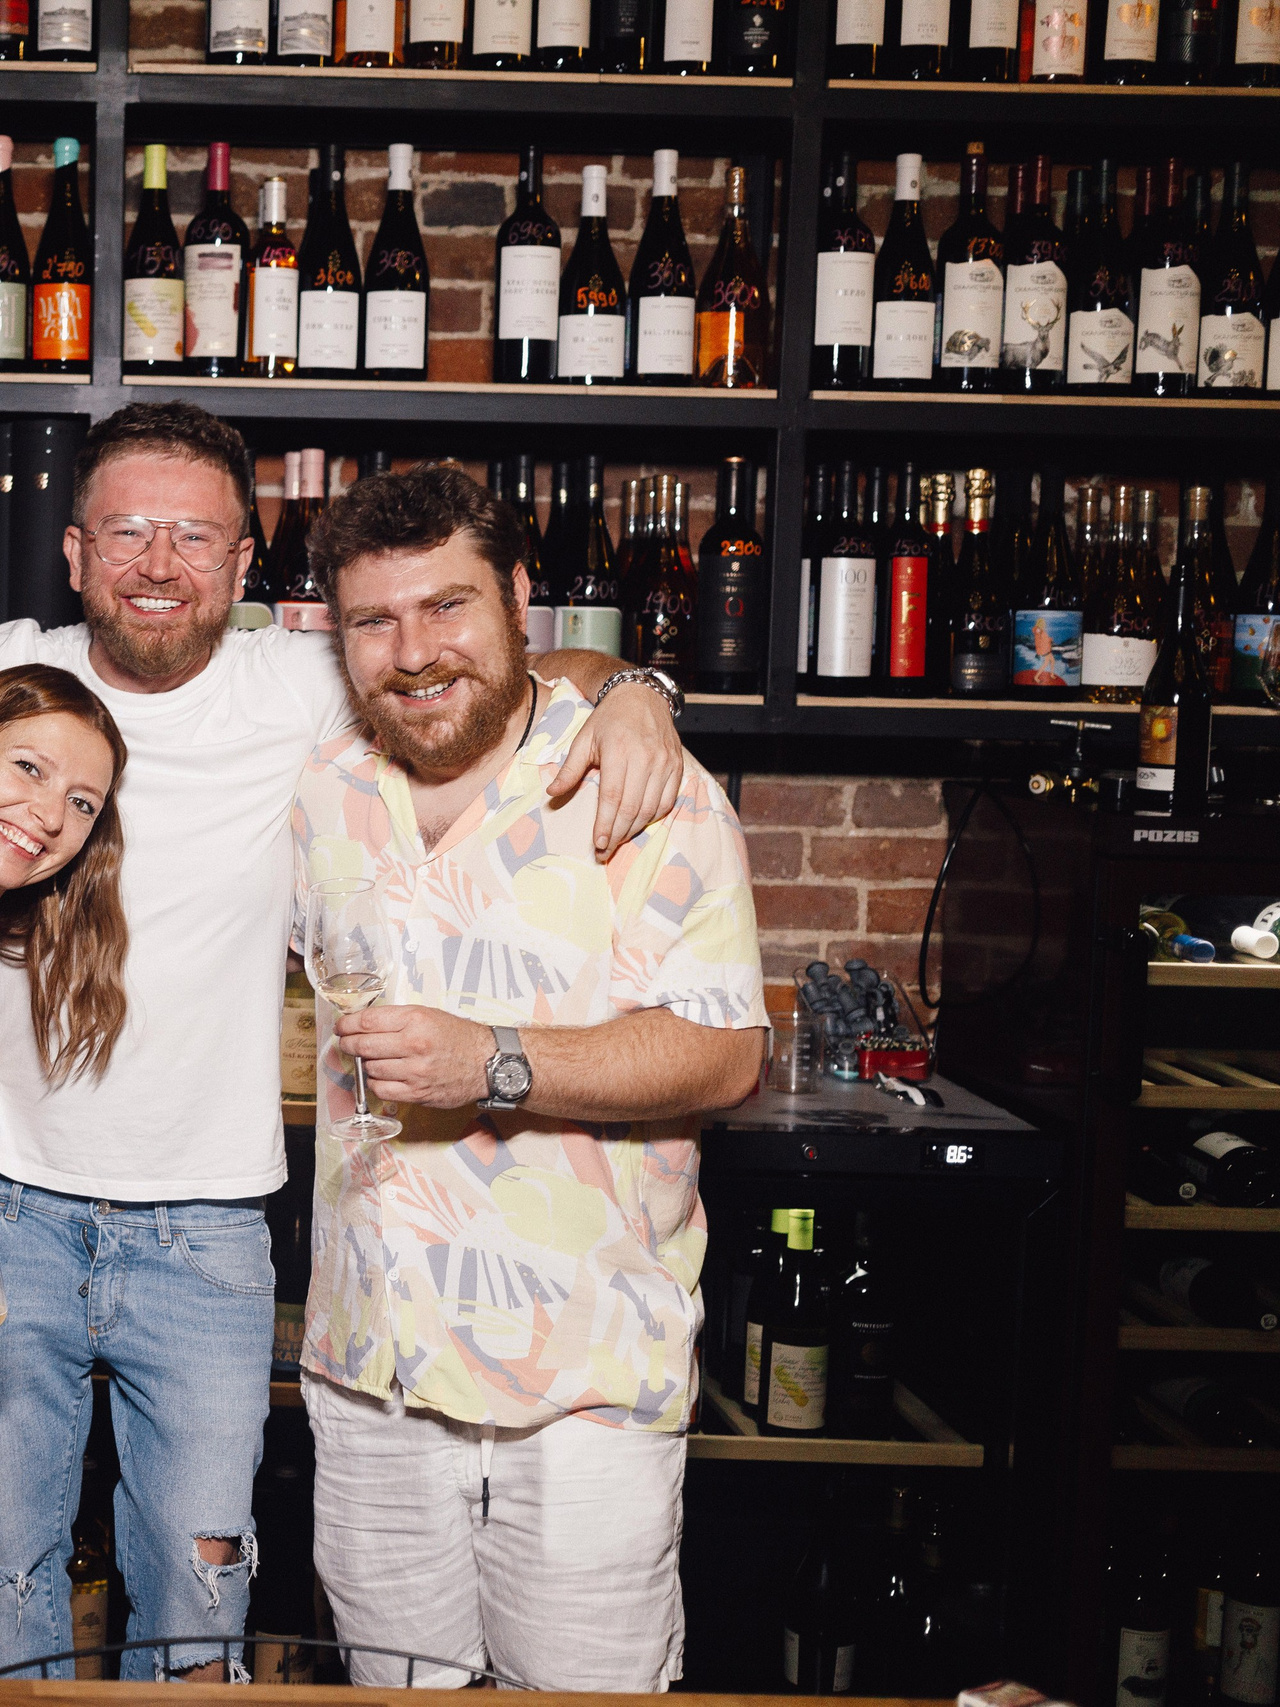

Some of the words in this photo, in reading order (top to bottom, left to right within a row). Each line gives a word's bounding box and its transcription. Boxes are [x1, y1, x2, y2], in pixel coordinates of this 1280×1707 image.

[577, 287, 618, 309] 5990
[641, 591, 693, 615] 1900
[1133, 829, 1200, 844] POZIS
